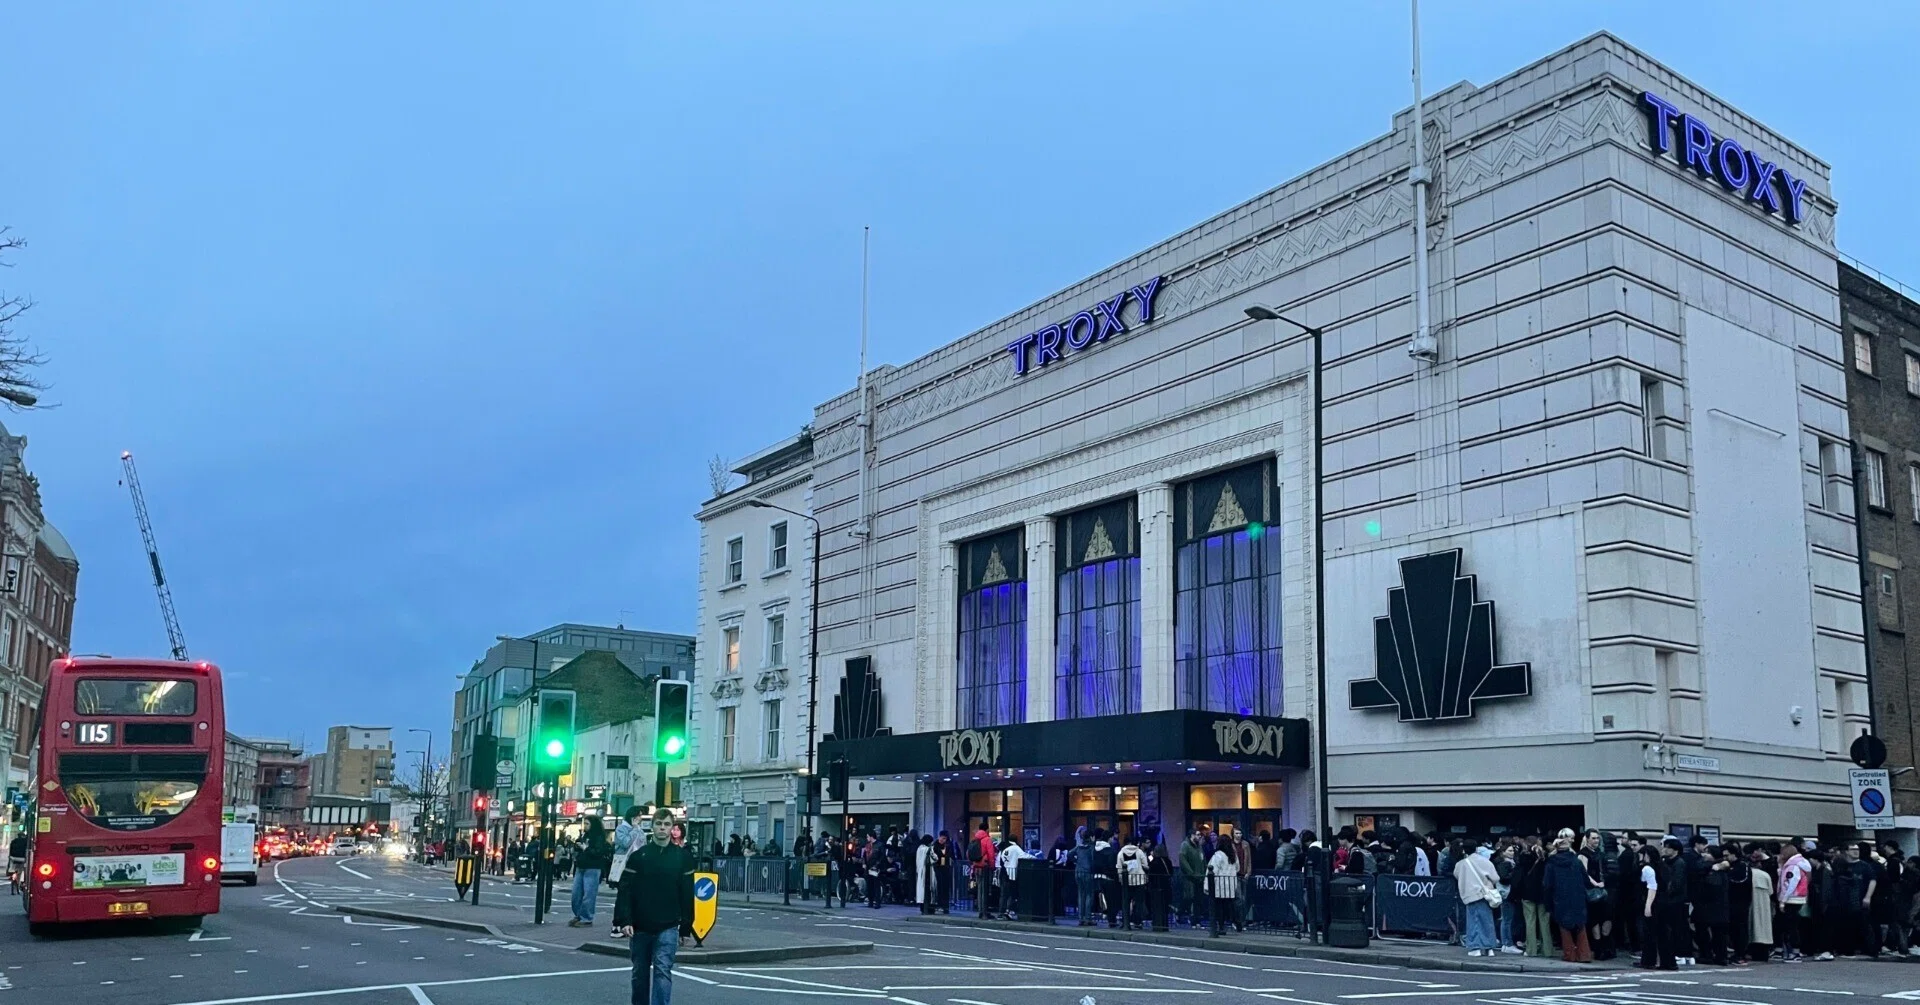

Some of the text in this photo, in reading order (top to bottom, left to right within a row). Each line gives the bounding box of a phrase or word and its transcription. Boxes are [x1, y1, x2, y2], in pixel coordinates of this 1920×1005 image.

[1637, 91, 1806, 226] TROXY
[1007, 276, 1163, 375] TROXY
[80, 724, 108, 742] 115
[938, 729, 1001, 769] TROXY
[1212, 718, 1284, 759] TROXY
[1254, 875, 1289, 891] TROXY
[1394, 880, 1436, 898] TROXY
